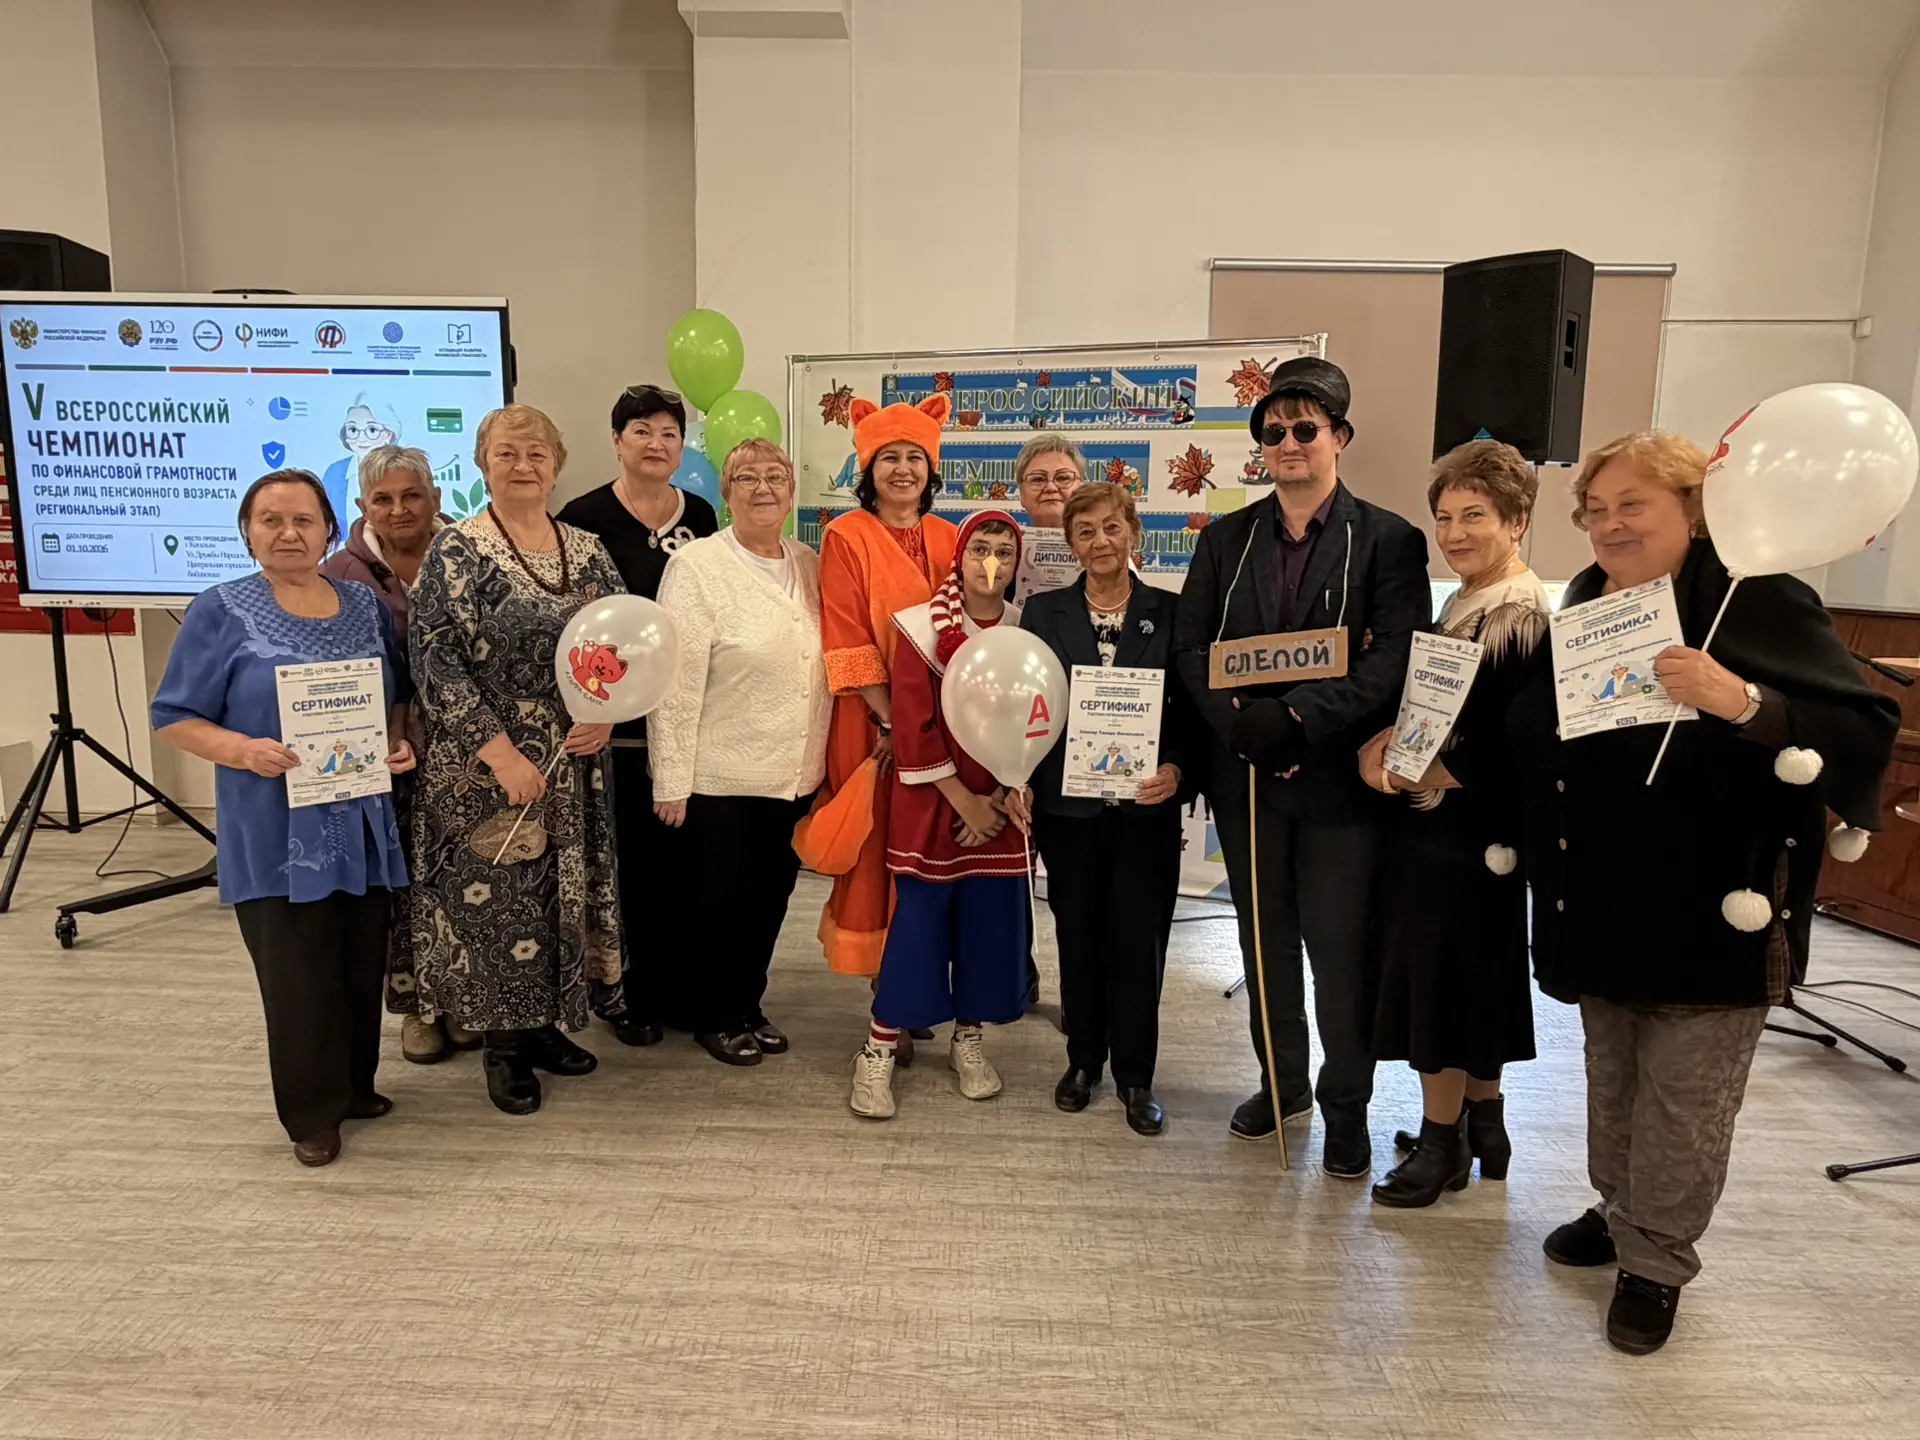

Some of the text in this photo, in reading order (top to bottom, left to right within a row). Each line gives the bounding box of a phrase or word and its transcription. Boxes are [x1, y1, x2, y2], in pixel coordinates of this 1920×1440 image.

[256, 328, 288, 338] НИФИ
[21, 382, 230, 424] V ВСЕРОССИЙСКИЙ
[27, 429, 187, 459] ЧЕМПИОНАТ
[31, 462, 237, 481] ПО ФИНАНСОВОЙ ГРАМОТНОСТИ
[33, 484, 237, 500] СРЕДИ ЛИЦ ПЕНСИОННОГО ВОЗРАСТА
[36, 502, 161, 518] (РЕГИОНАЛЬНЫЙ ЭТАП)
[1034, 552, 1077, 563] ДИПЛОМ
[1565, 609, 1660, 649] СЕРТИФИКАТ
[1224, 639, 1329, 675] СЛЕПОЙ
[1414, 668, 1465, 691] СЕРТИФИКАТ
[292, 694, 373, 712] СЕРТИФИКАТ
[1080, 700, 1152, 713] СЕРТИФИКАТ
[1617, 717, 1636, 726] 2026
